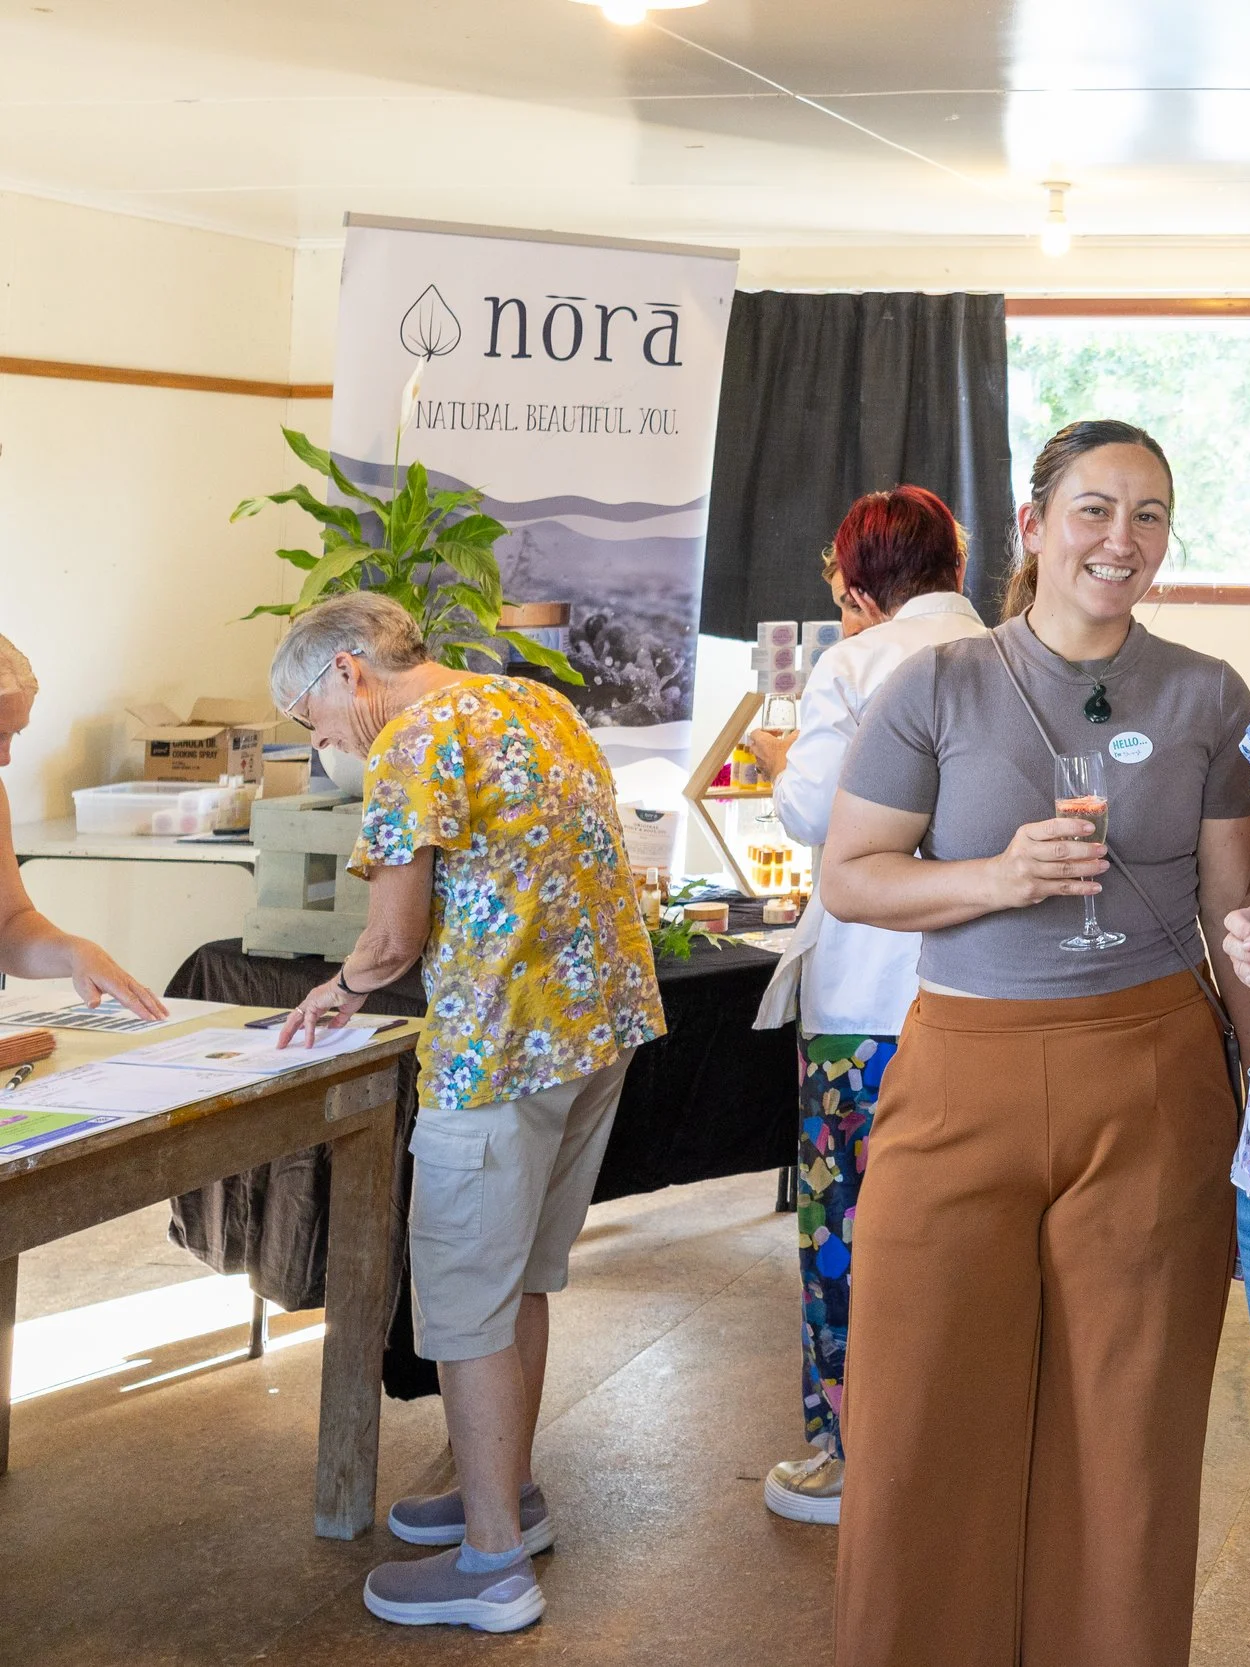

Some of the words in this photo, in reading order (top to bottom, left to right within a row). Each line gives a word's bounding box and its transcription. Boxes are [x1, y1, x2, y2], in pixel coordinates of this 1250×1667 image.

[483, 294, 683, 367] nōrā
[415, 399, 519, 431] NATURAL.
[526, 403, 632, 435] BEAUTIFUL.
[638, 407, 679, 436] YOU.
[172, 750, 197, 759] COOKING
[199, 751, 218, 760] SPRAY
